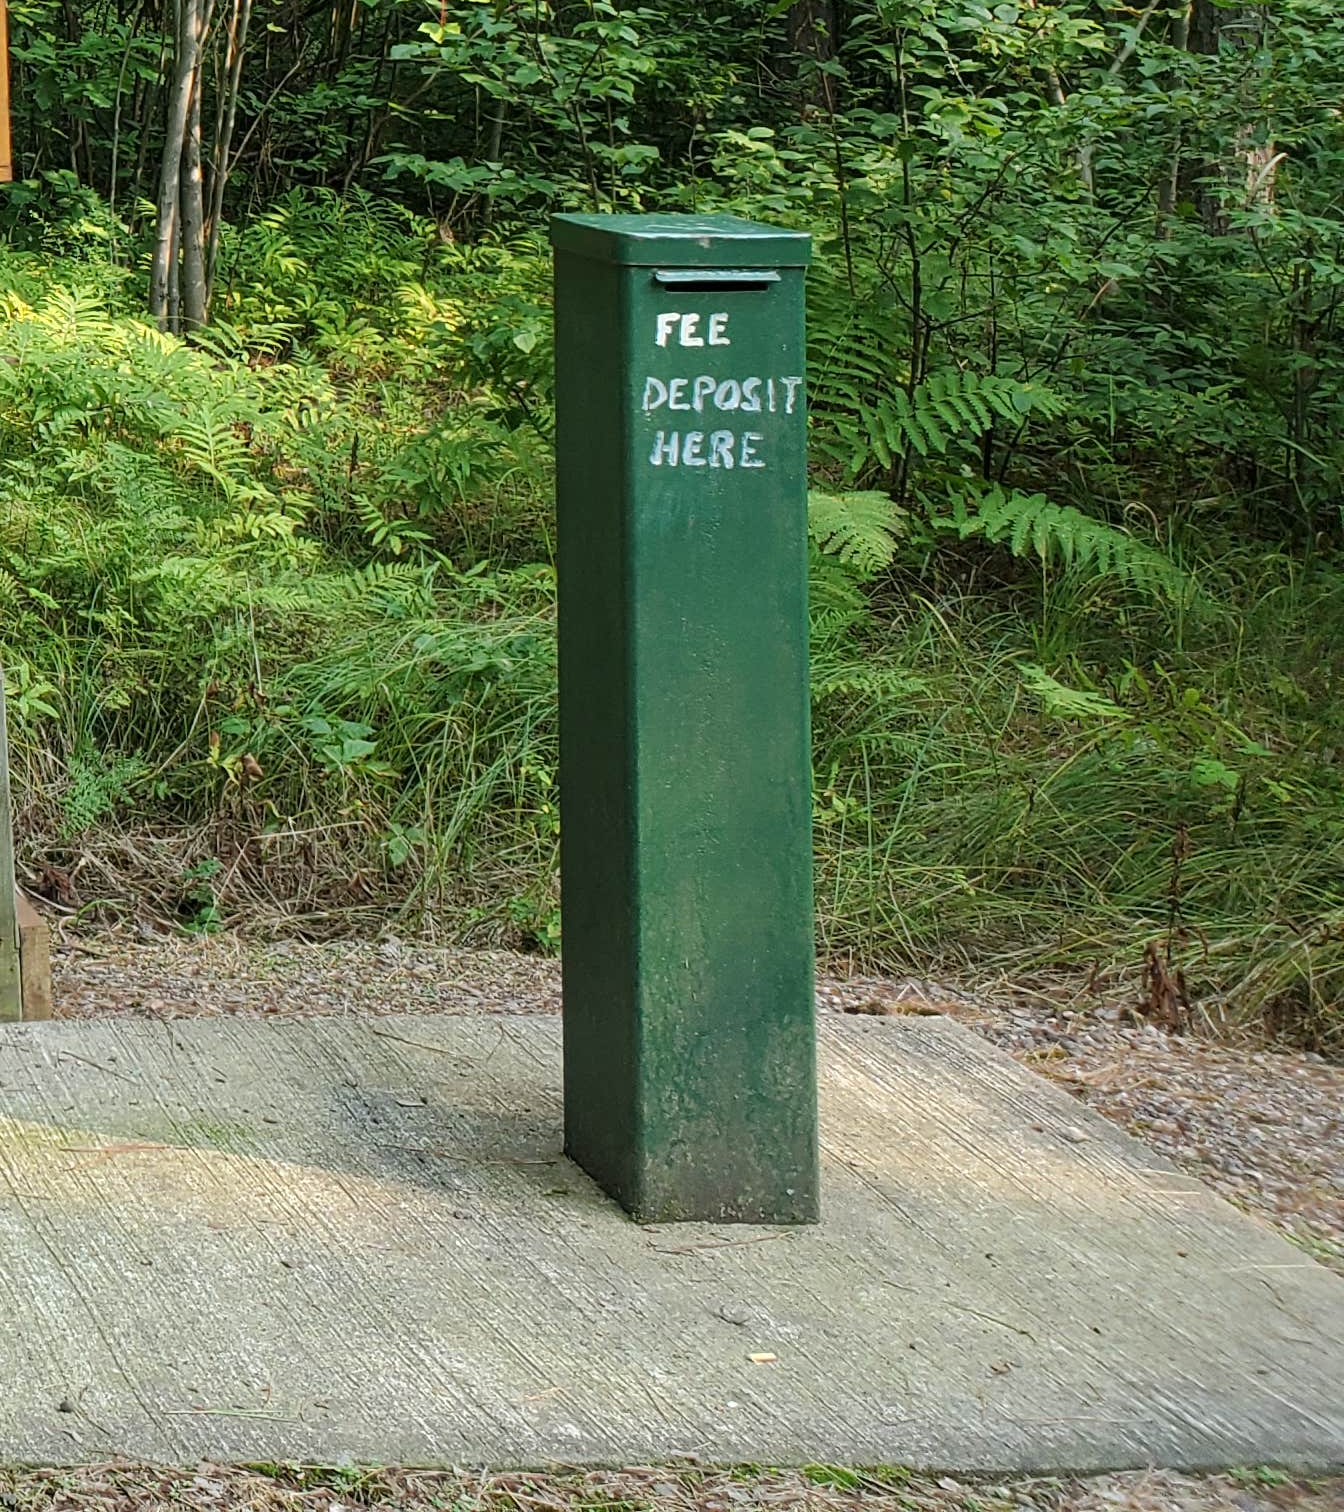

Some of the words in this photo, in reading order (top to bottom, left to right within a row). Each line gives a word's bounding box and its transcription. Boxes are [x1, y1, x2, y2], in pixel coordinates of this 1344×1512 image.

[654, 312, 731, 347] FEE
[642, 376, 803, 414] DEPOSIT
[649, 431, 766, 469] HERE
